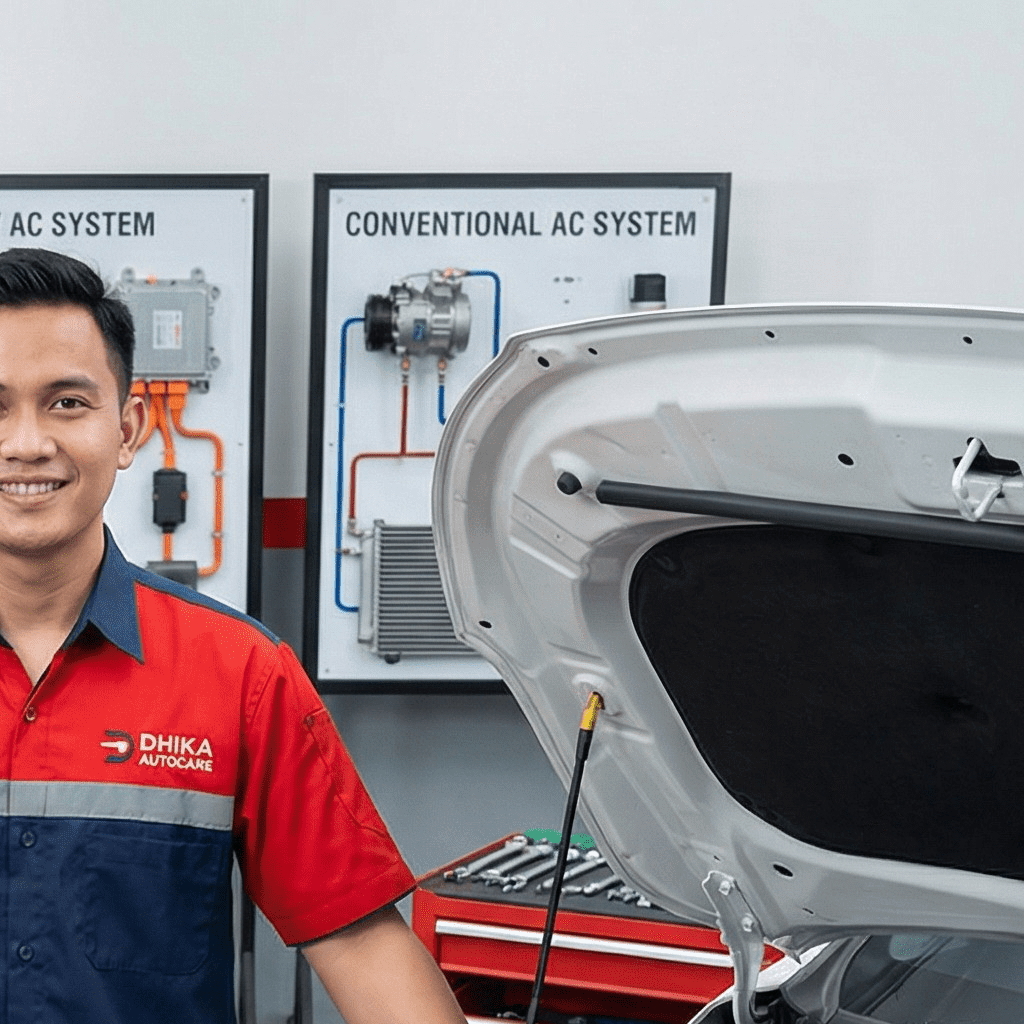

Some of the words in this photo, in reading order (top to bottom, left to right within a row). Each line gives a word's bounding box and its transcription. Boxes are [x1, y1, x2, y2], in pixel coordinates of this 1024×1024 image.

[9, 211, 43, 237] AC
[51, 211, 155, 237] SYSTEM
[345, 210, 542, 237] CONVENTIONAL
[551, 210, 585, 237] AC
[593, 210, 696, 237] SYSTEM
[139, 733, 213, 757] DHIKA
[138, 753, 213, 772] AUTOCARE
